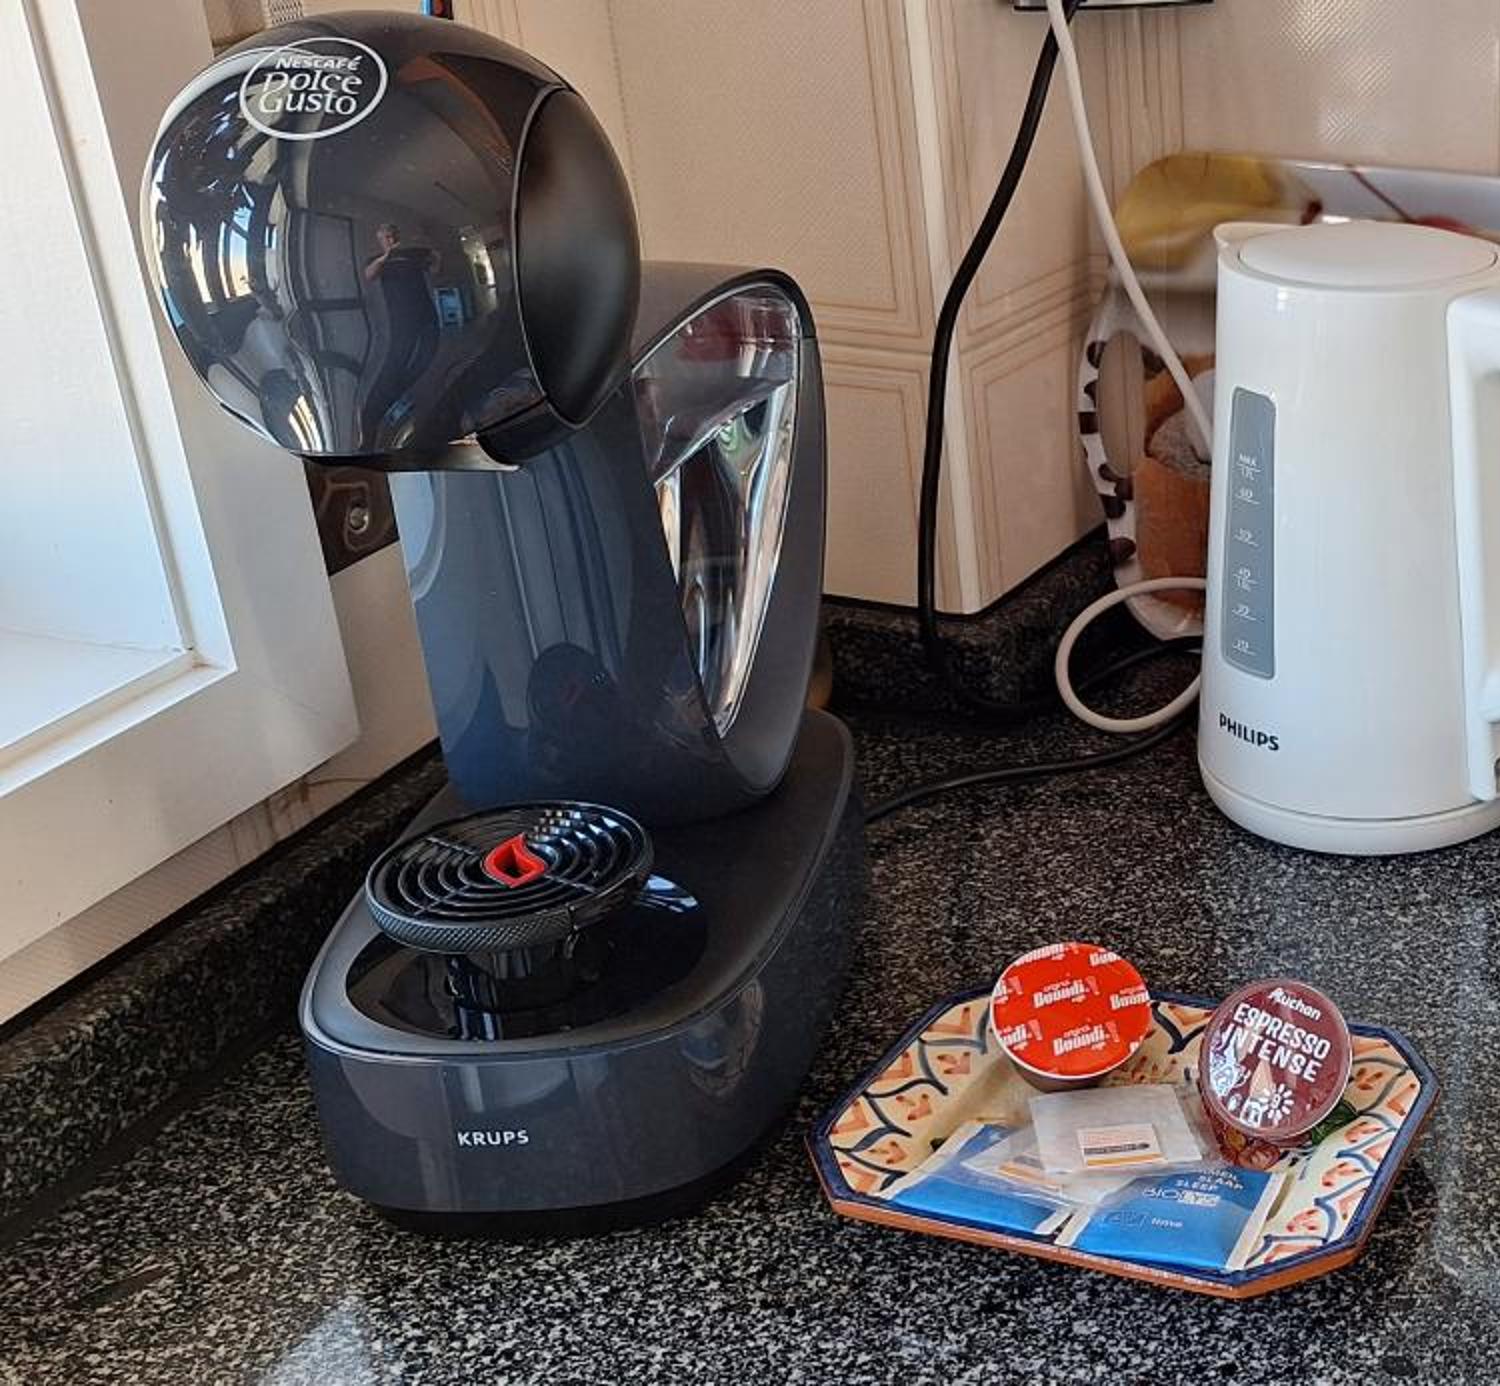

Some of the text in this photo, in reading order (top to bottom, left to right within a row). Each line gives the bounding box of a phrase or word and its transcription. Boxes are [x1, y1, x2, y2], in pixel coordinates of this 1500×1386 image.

[275, 55, 363, 71] NESCAFÉ
[263, 69, 363, 95] Dolce
[258, 91, 357, 116] Gusto
[1219, 711, 1280, 751] PHILIPS
[1268, 987, 1322, 1021] Auchan
[1233, 1003, 1331, 1060] ESPRESSO
[1221, 1023, 1322, 1083] INTENSE
[457, 1130, 529, 1146] KRUPS
